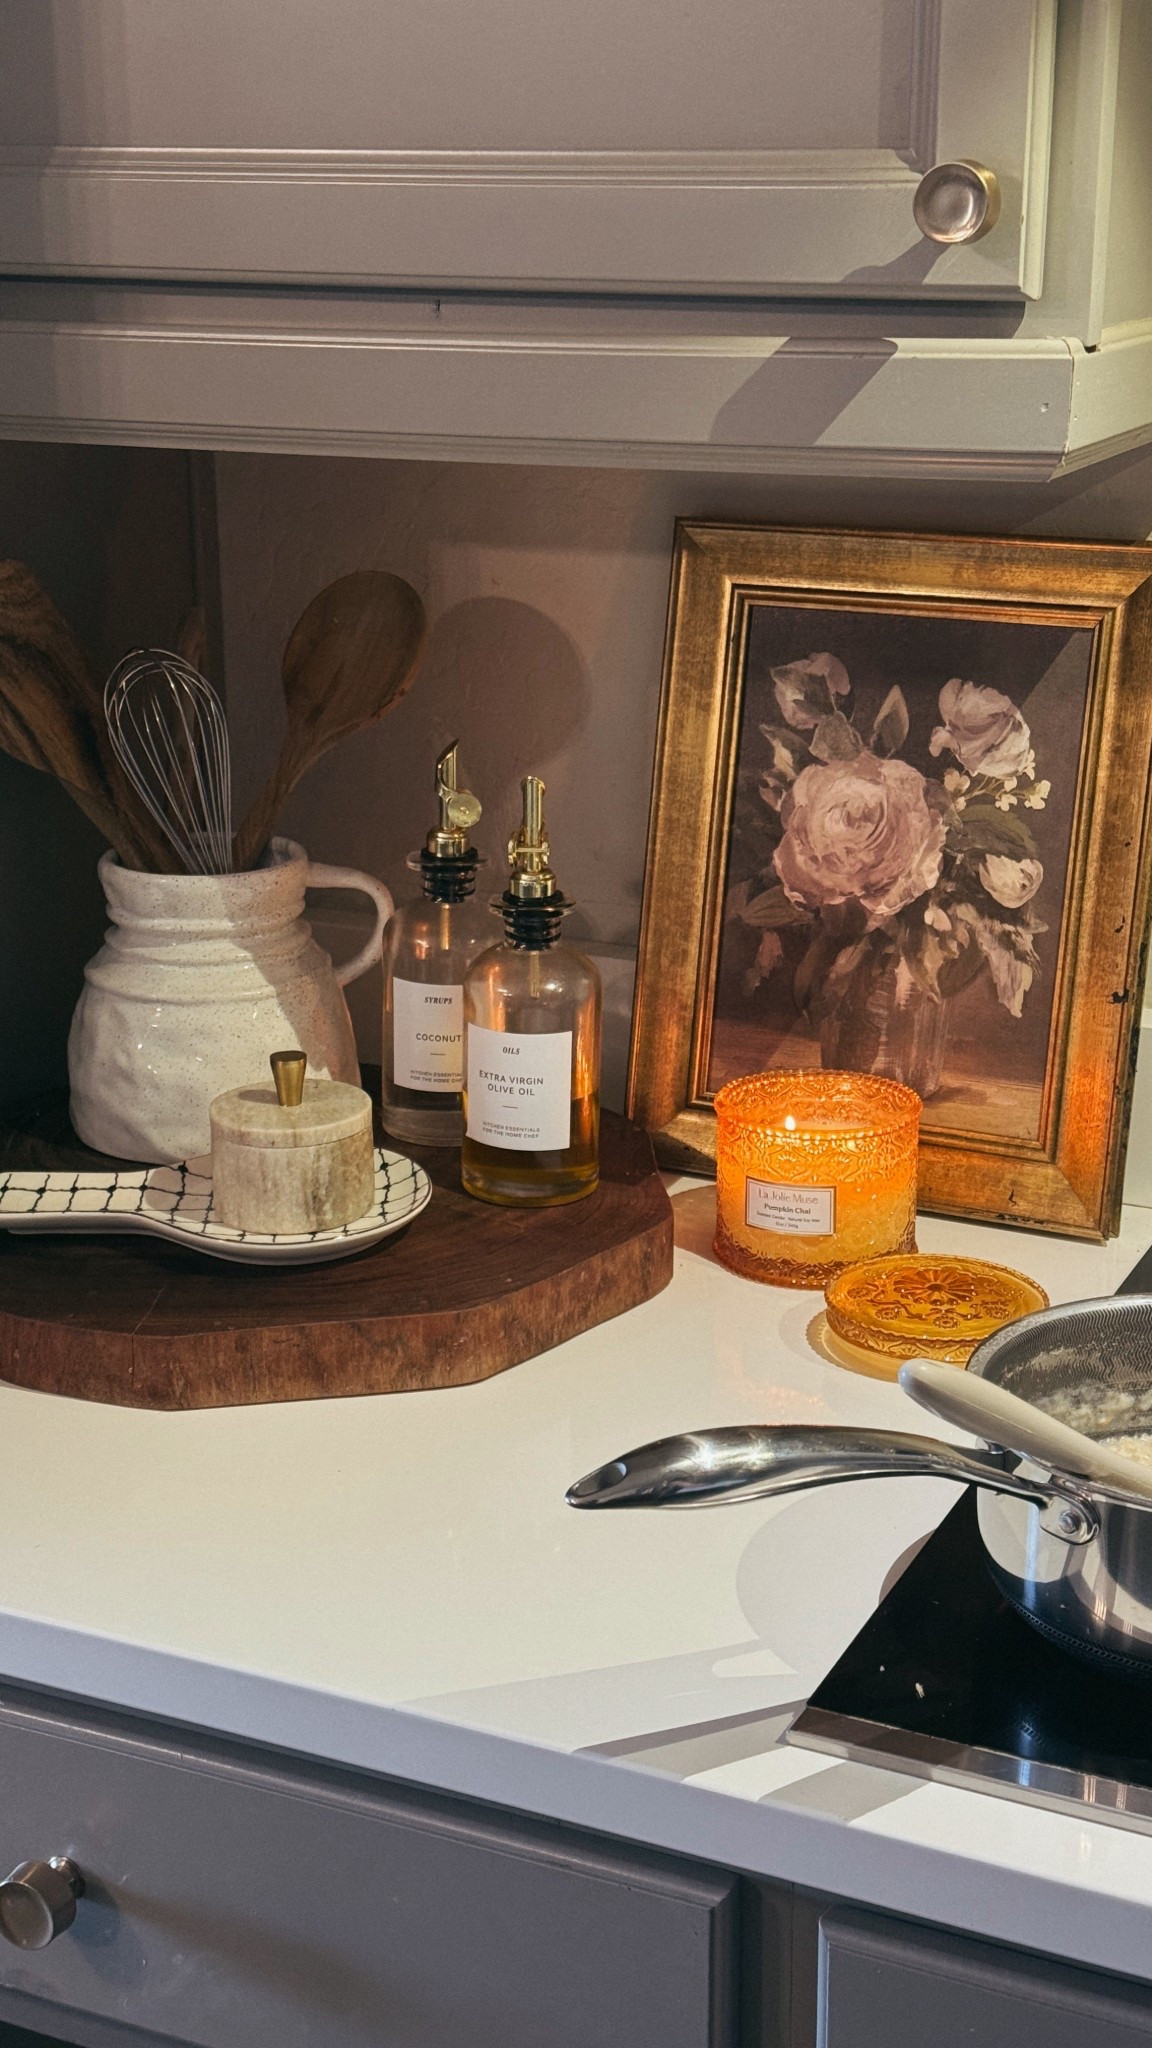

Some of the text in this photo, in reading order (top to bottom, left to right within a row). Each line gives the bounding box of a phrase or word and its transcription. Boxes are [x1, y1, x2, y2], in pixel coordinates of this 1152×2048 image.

[424, 997, 452, 1005] SYRUPS
[416, 1033, 461, 1042] COCONUT
[502, 1046, 520, 1055] OILS
[479, 1069, 544, 1086] EXTRA VIRGIN
[487, 1083, 536, 1096] OLIVE OIL
[482, 1121, 541, 1133] KITCHEN ESSENTIALS
[493, 1129, 504, 1137] THE
[505, 1131, 522, 1139] HOME
[759, 1188, 818, 1204] La Jolie Muse
[764, 1202, 794, 1214] Pumpkin
